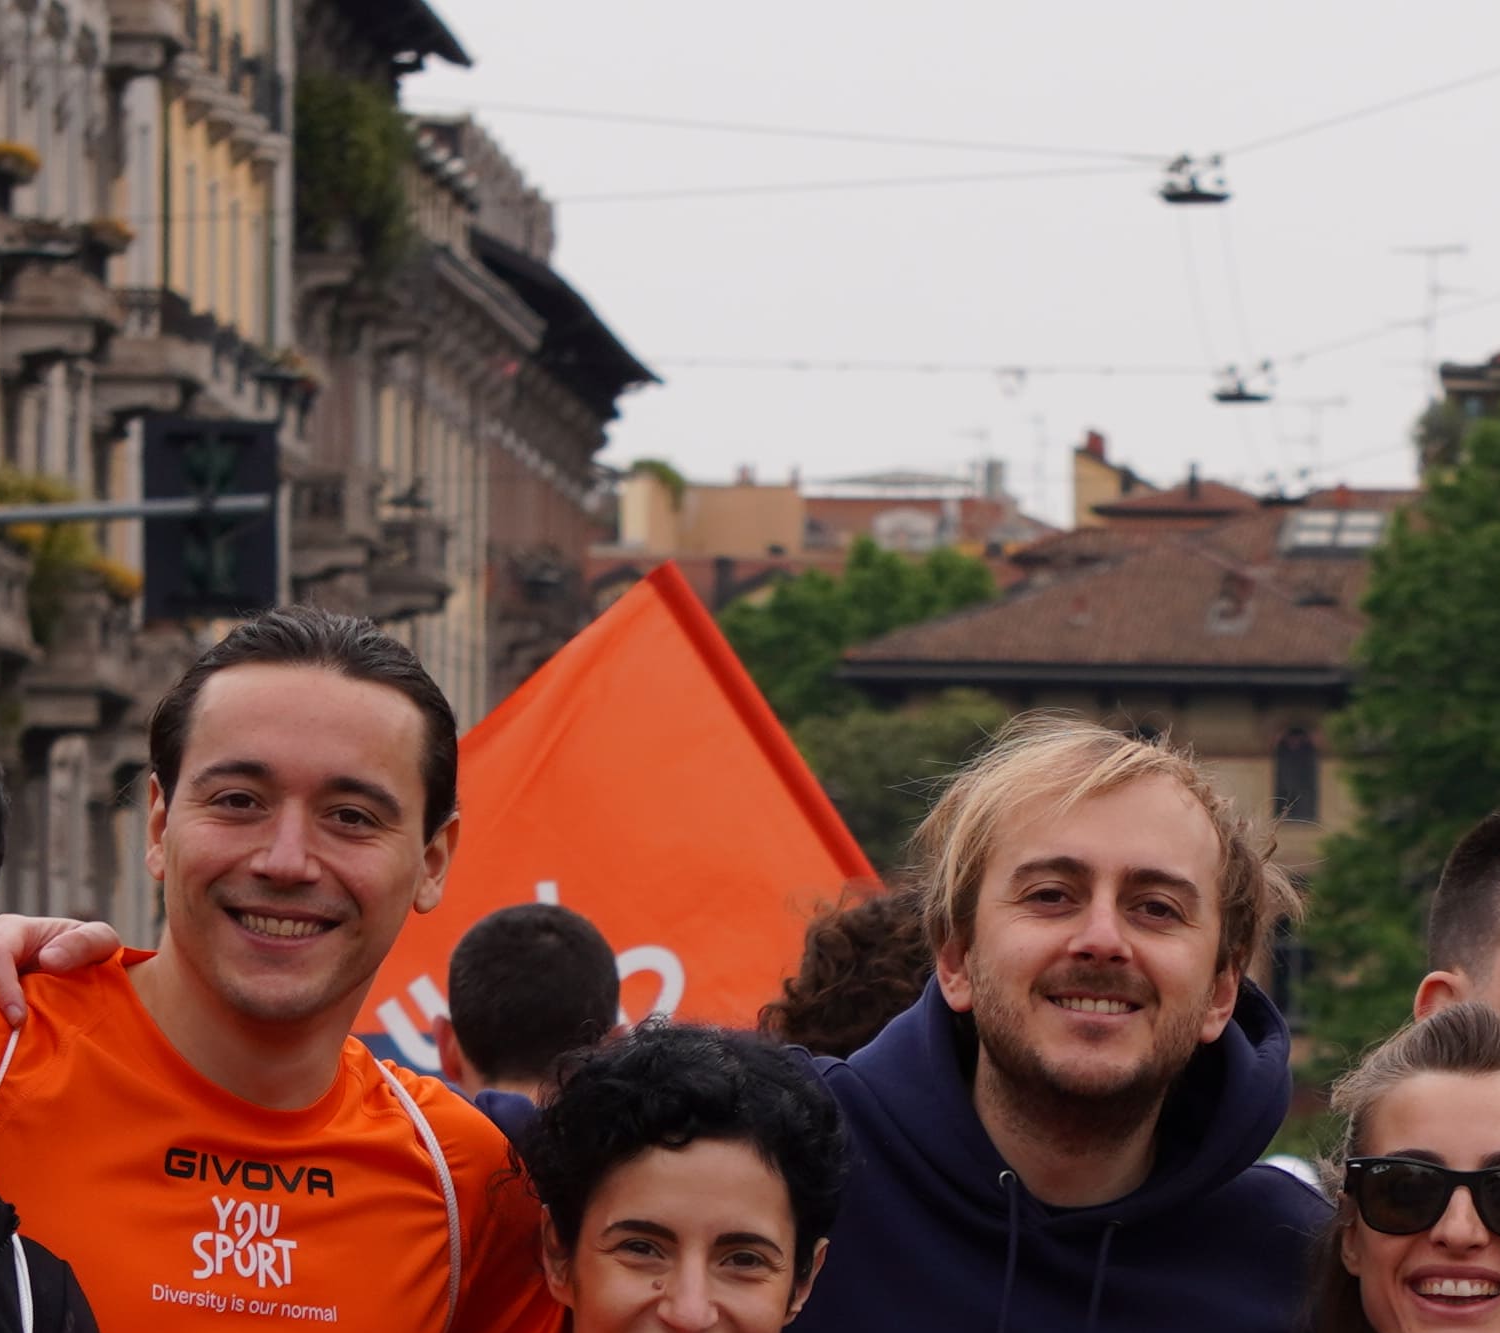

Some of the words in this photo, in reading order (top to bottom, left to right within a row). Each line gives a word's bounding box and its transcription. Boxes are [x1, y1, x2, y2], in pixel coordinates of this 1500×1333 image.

[164, 1147, 334, 1197] GIVOVA
[211, 1195, 280, 1240] YOU
[192, 1231, 297, 1288] SPORT
[151, 1284, 227, 1312] Diversity
[231, 1294, 244, 1311] is
[249, 1300, 277, 1316] our
[280, 1304, 337, 1322] normal
